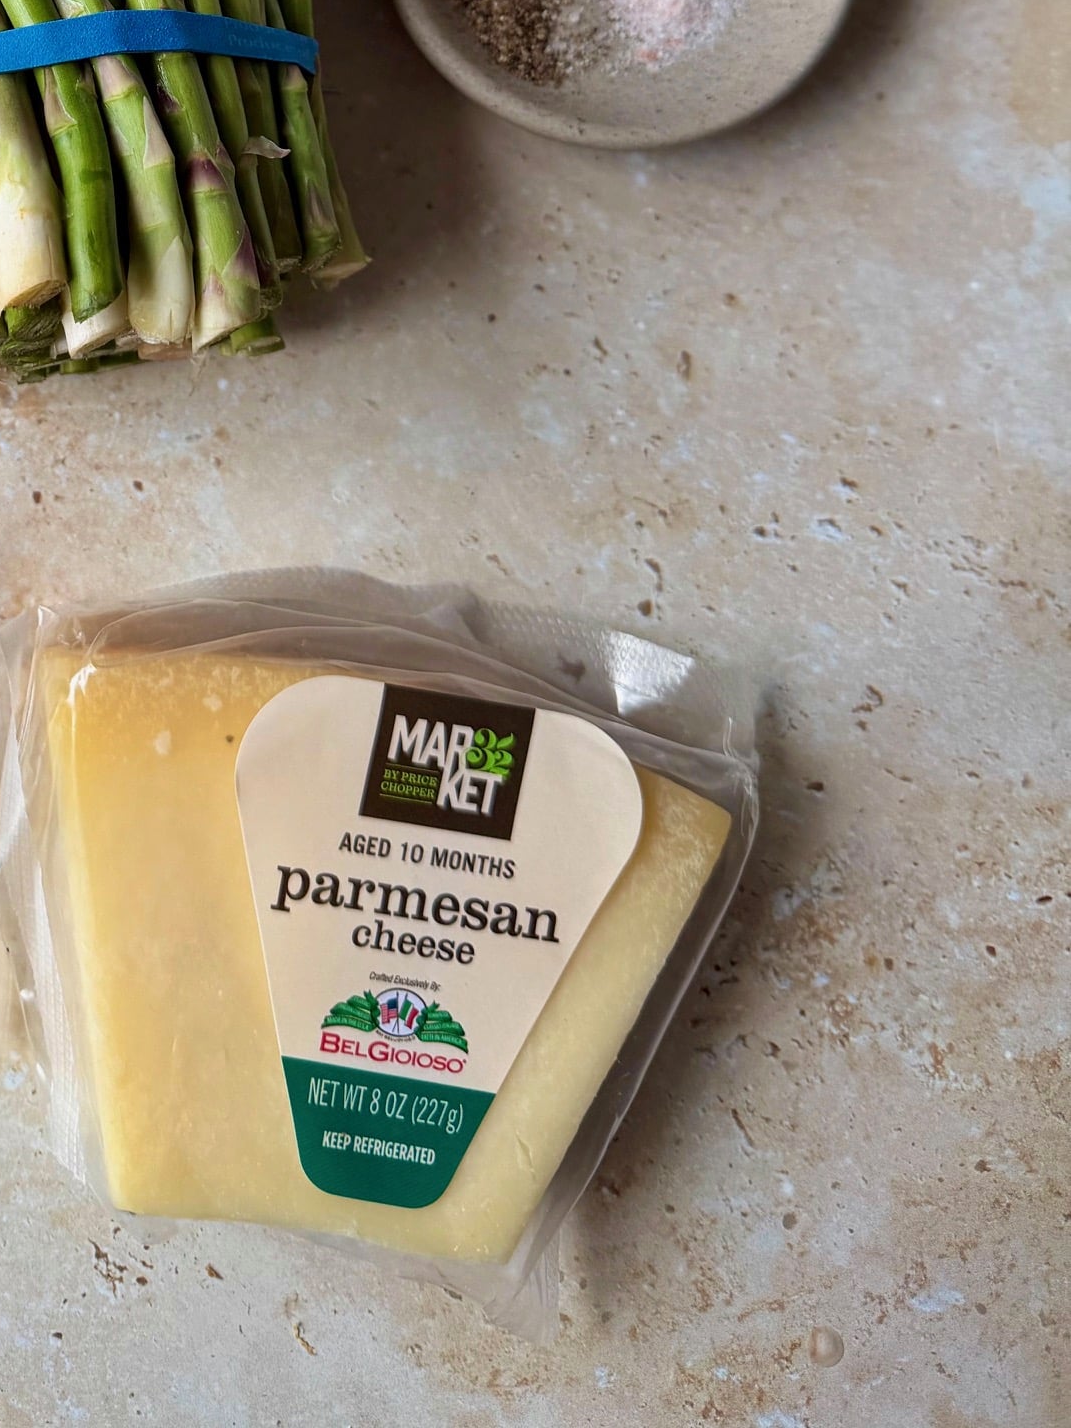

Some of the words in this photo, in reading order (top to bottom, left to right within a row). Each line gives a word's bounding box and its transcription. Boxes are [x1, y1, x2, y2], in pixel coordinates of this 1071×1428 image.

[387, 714, 475, 774] MAR
[380, 780, 436, 799] CHOPPER
[383, 768, 401, 780] BY
[401, 770, 438, 787] PRICE
[436, 768, 503, 815] KET
[338, 831, 392, 859] AGED
[400, 841, 425, 865] 10
[429, 846, 517, 880] MONTHS
[269, 863, 560, 944] parmesan
[351, 919, 476, 965] cheese
[369, 971, 394, 984] Crafted
[394, 974, 430, 990] Exclusively
[319, 1030, 465, 1074] BELGIOIOSO
[307, 1077, 340, 1107] NET
[343, 1084, 368, 1112] WT
[369, 1088, 381, 1115] 8
[385, 1091, 408, 1120] OZ
[411, 1095, 464, 1135] (227g)
[322, 1130, 352, 1151] KEEP
[353, 1136, 436, 1166] REFRIGERATED
